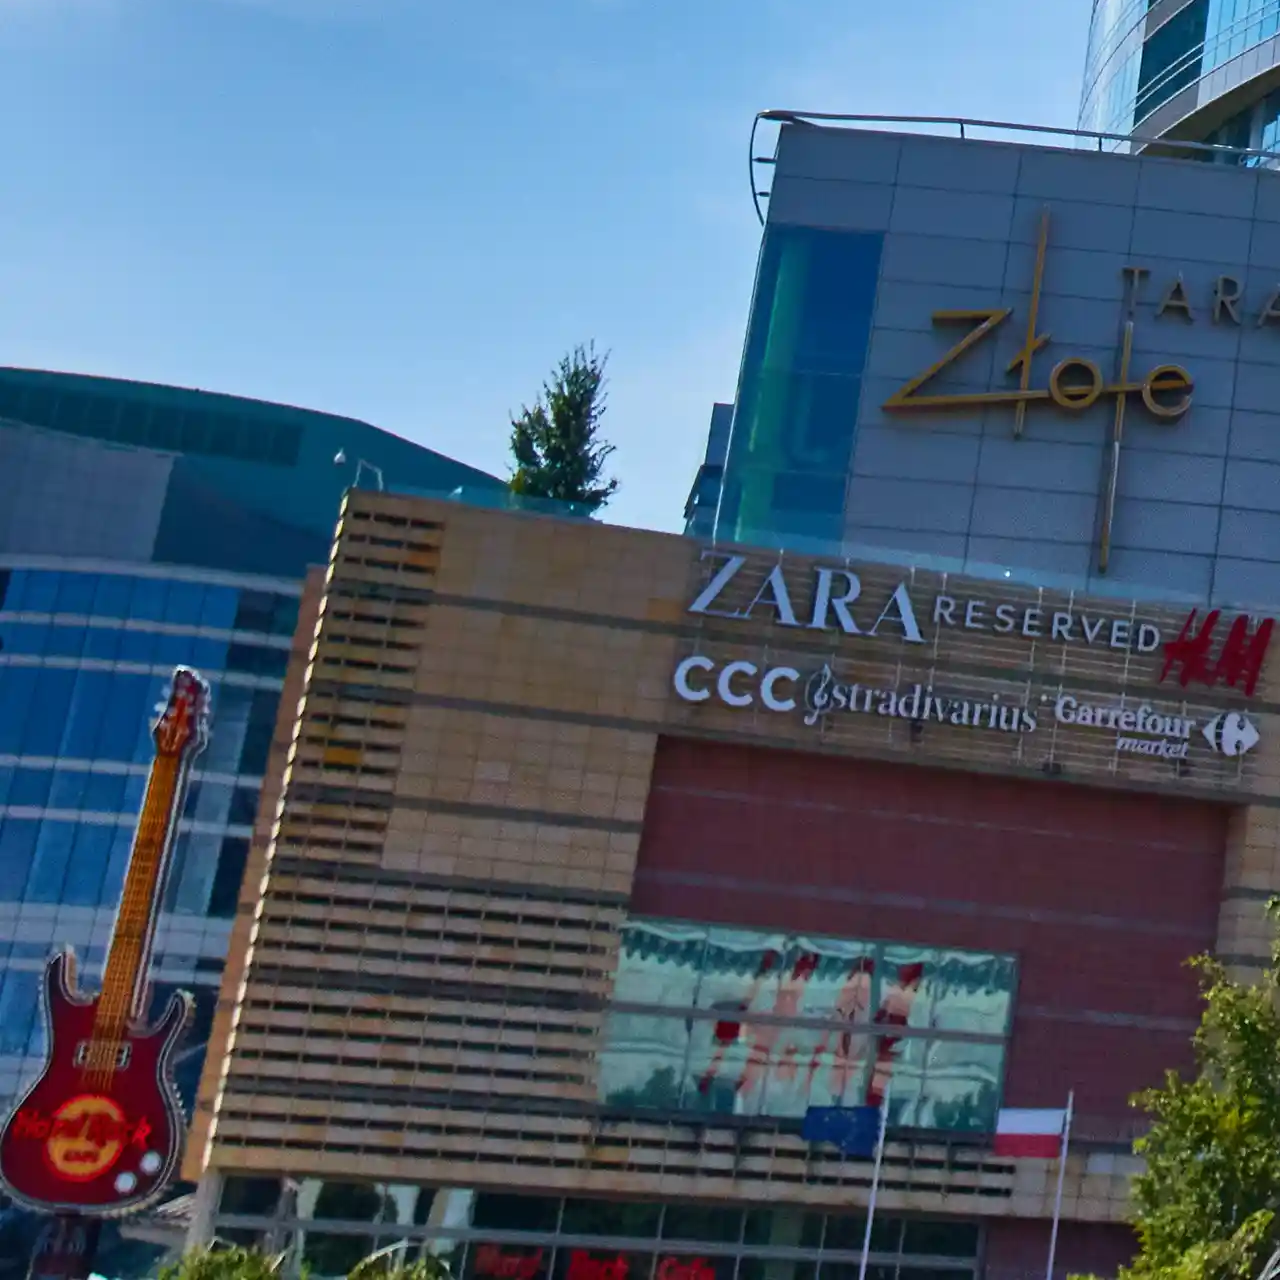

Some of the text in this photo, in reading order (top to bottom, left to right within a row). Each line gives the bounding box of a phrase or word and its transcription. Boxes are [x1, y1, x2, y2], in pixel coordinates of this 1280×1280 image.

[688, 549, 928, 644] ZARA
[933, 595, 1161, 653] RESERVED
[673, 656, 800, 712] CCC
[1054, 694, 1198, 739] Carrefour
[1116, 735, 1189, 759] market
